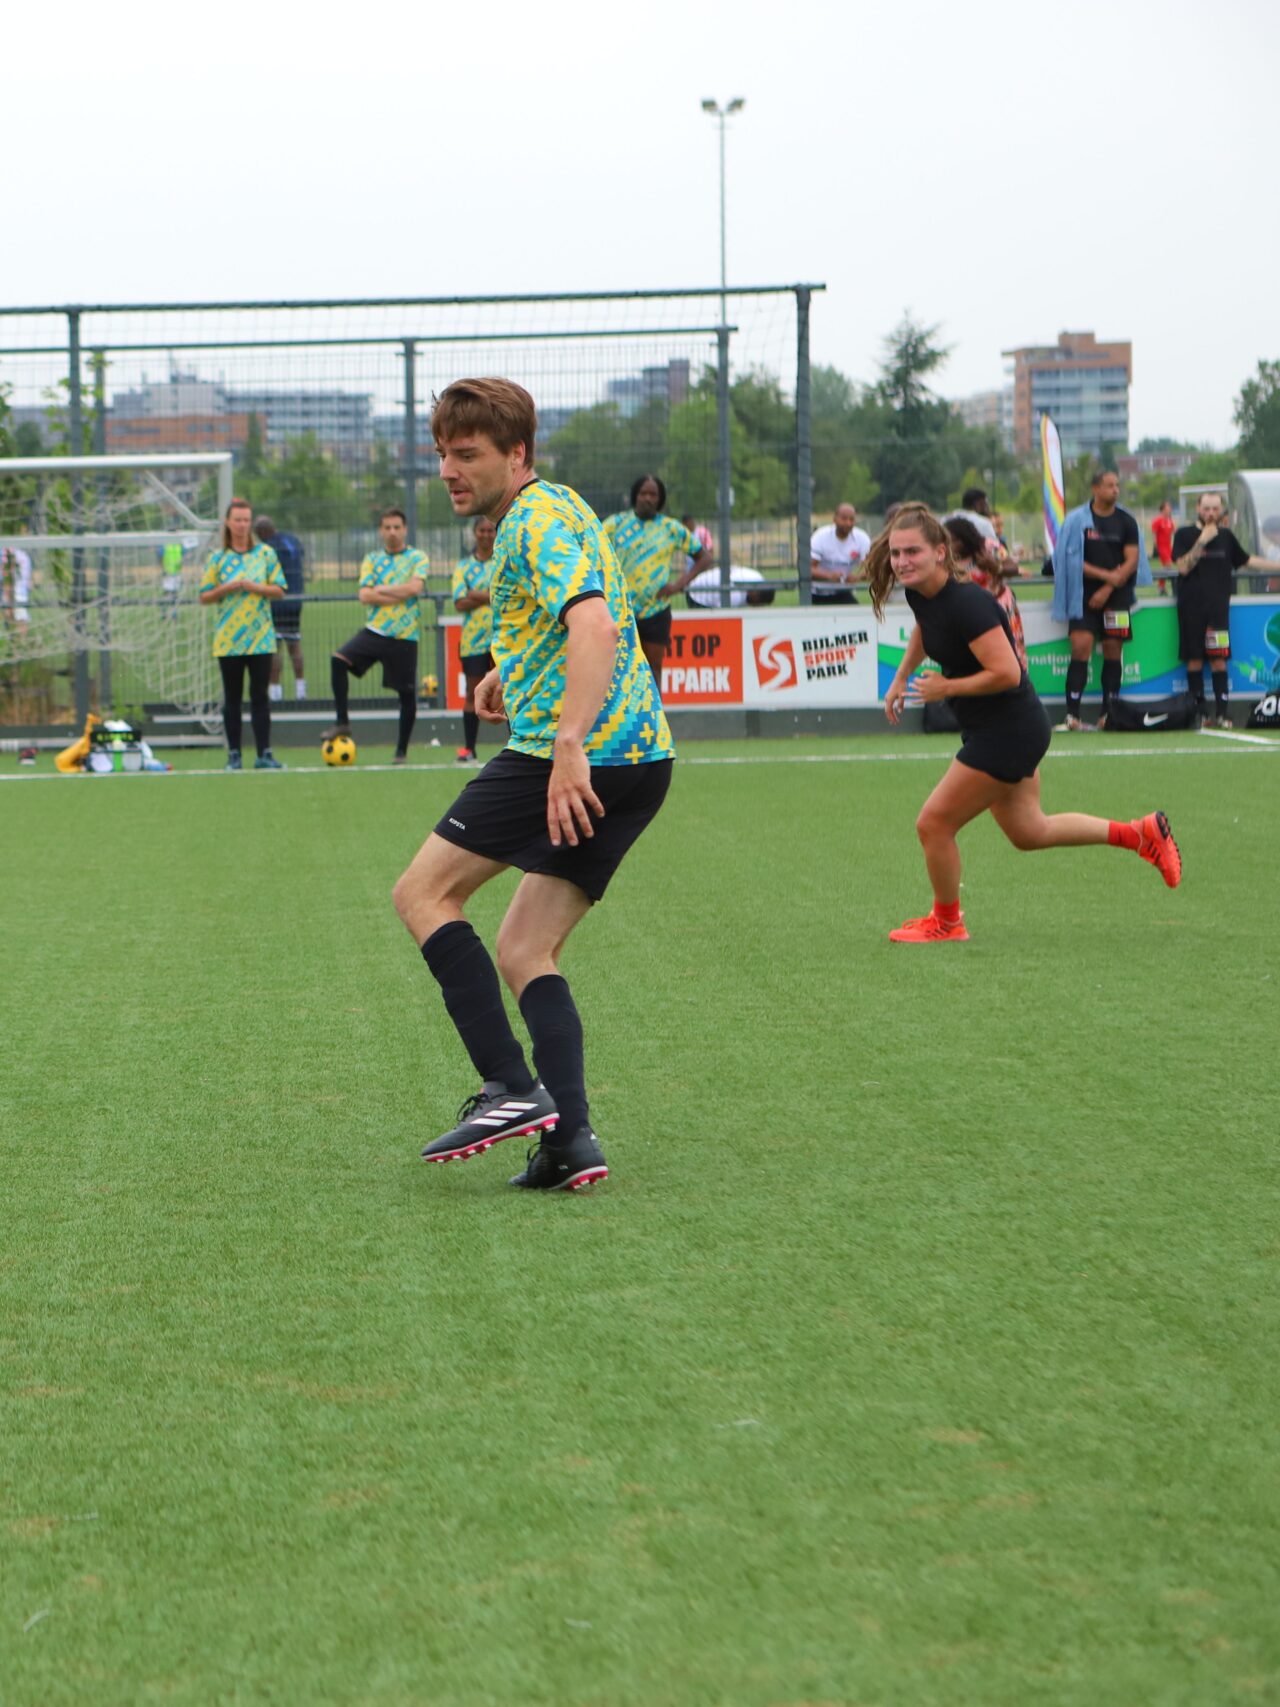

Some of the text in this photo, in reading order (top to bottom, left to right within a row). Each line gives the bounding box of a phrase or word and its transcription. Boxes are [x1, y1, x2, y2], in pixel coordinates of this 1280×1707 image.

[692, 633, 721, 658] OP
[804, 647, 857, 667] SPORT
[806, 663, 849, 681] PARK
